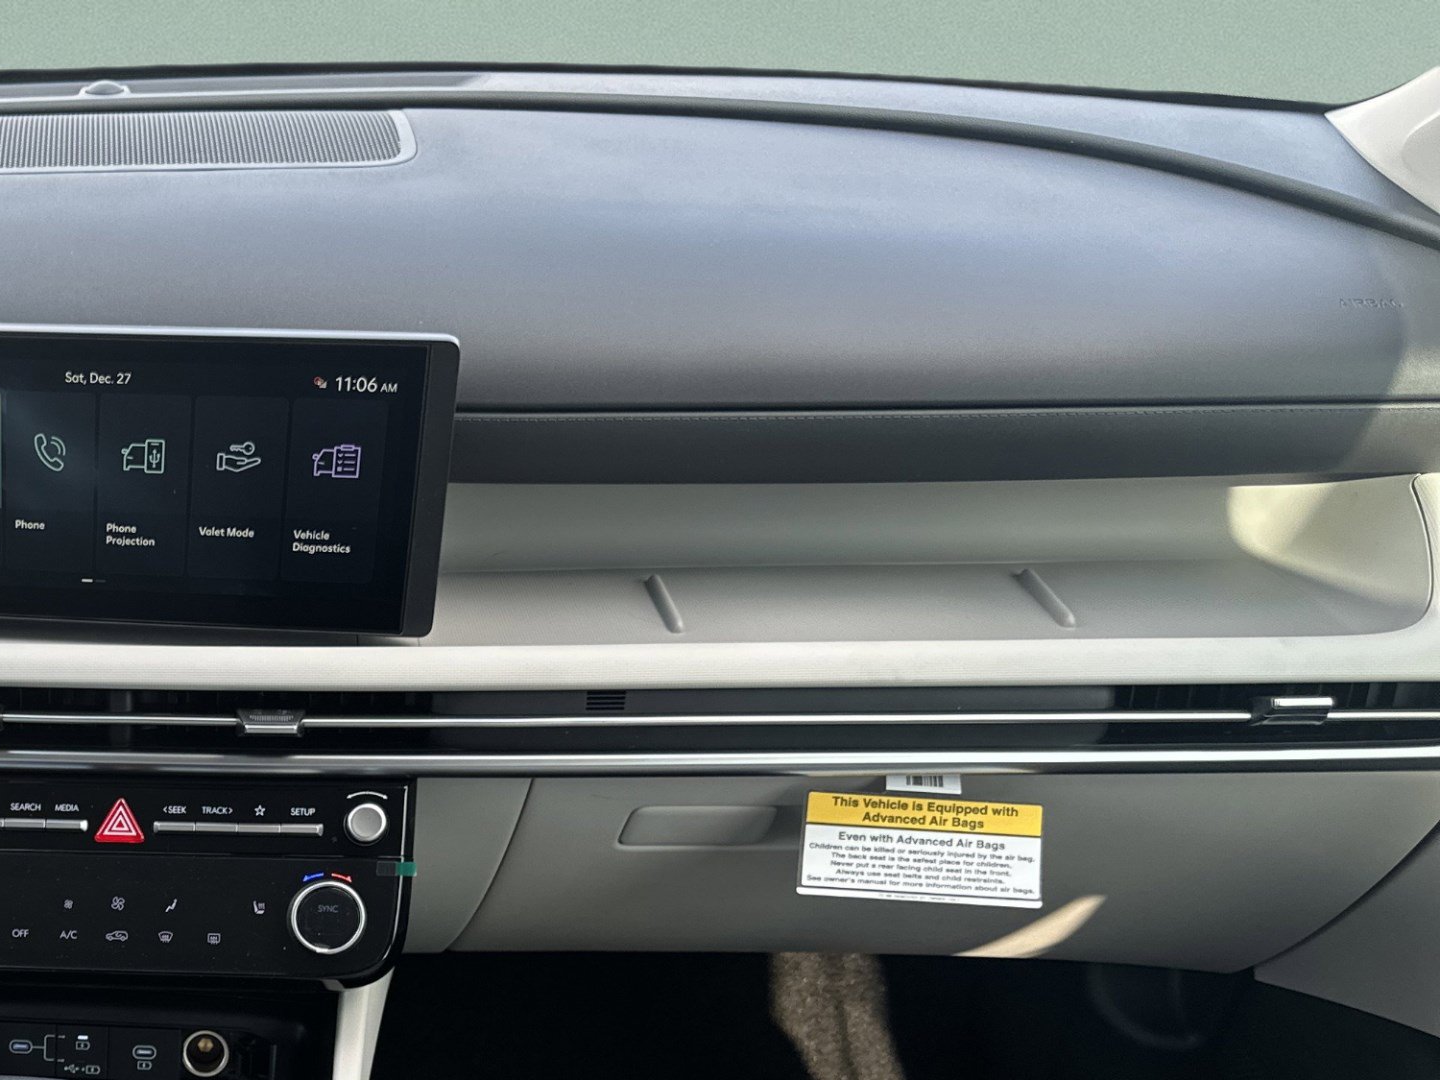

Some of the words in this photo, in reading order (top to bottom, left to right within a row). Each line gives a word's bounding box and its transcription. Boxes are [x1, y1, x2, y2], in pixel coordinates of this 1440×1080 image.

[65, 371, 87, 385] Sat,
[89, 372, 114, 384] Dec.
[116, 372, 132, 385] 27
[335, 376, 378, 393] 11:06
[380, 383, 398, 393] AM
[15, 519, 45, 531] Phone
[106, 523, 137, 534] Phone
[199, 526, 225, 538] Valet
[226, 527, 255, 538] Mode
[293, 529, 330, 541] Vehicle
[106, 535, 156, 547] Projection
[292, 542, 351, 555] Diagnostics
[10, 802, 41, 812] SEARCH
[55, 803, 80, 812] MEDIA
[290, 807, 316, 817] SETUP
[832, 795, 859, 808] This
[863, 798, 909, 811] Vehicle
[927, 802, 988, 817] Equipped
[991, 806, 1019, 817] with
[862, 812, 926, 826] Advanced
[929, 816, 949, 827] Air
[952, 818, 985, 831] Bags
[838, 831, 867, 842] Even
[870, 834, 893, 844] with
[897, 835, 953, 847] Advanced
[956, 839, 973, 848] Air
[976, 840, 1006, 852] Bags
[809, 842, 843, 851] Children
[874, 846, 895, 854] killed
[908, 848, 945, 857] seriously
[947, 850, 975, 859] injured
[977, 852, 987, 860] by
[990, 852, 1003, 860] the
[832, 851, 846, 859] The
[848, 853, 867, 861] back
[912, 856, 937, 864] safest
[939, 859, 961, 867] place
[976, 861, 1013, 869] children.
[856, 861, 870, 869] put
[896, 864, 922, 873] facing
[923, 865, 943, 873] child
[835, 869, 864, 877] Always
[884, 871, 901, 879] seat
[903, 872, 922, 880] belts
[807, 874, 822, 882] See
[824, 876, 855, 884] owner's
[858, 877, 887, 885] manual
[925, 882, 973, 891] information
[974, 884, 998, 892] about
[317, 904, 339, 913] SYNC
[12, 928, 29, 938] OFF
[60, 930, 78, 940] A/C
